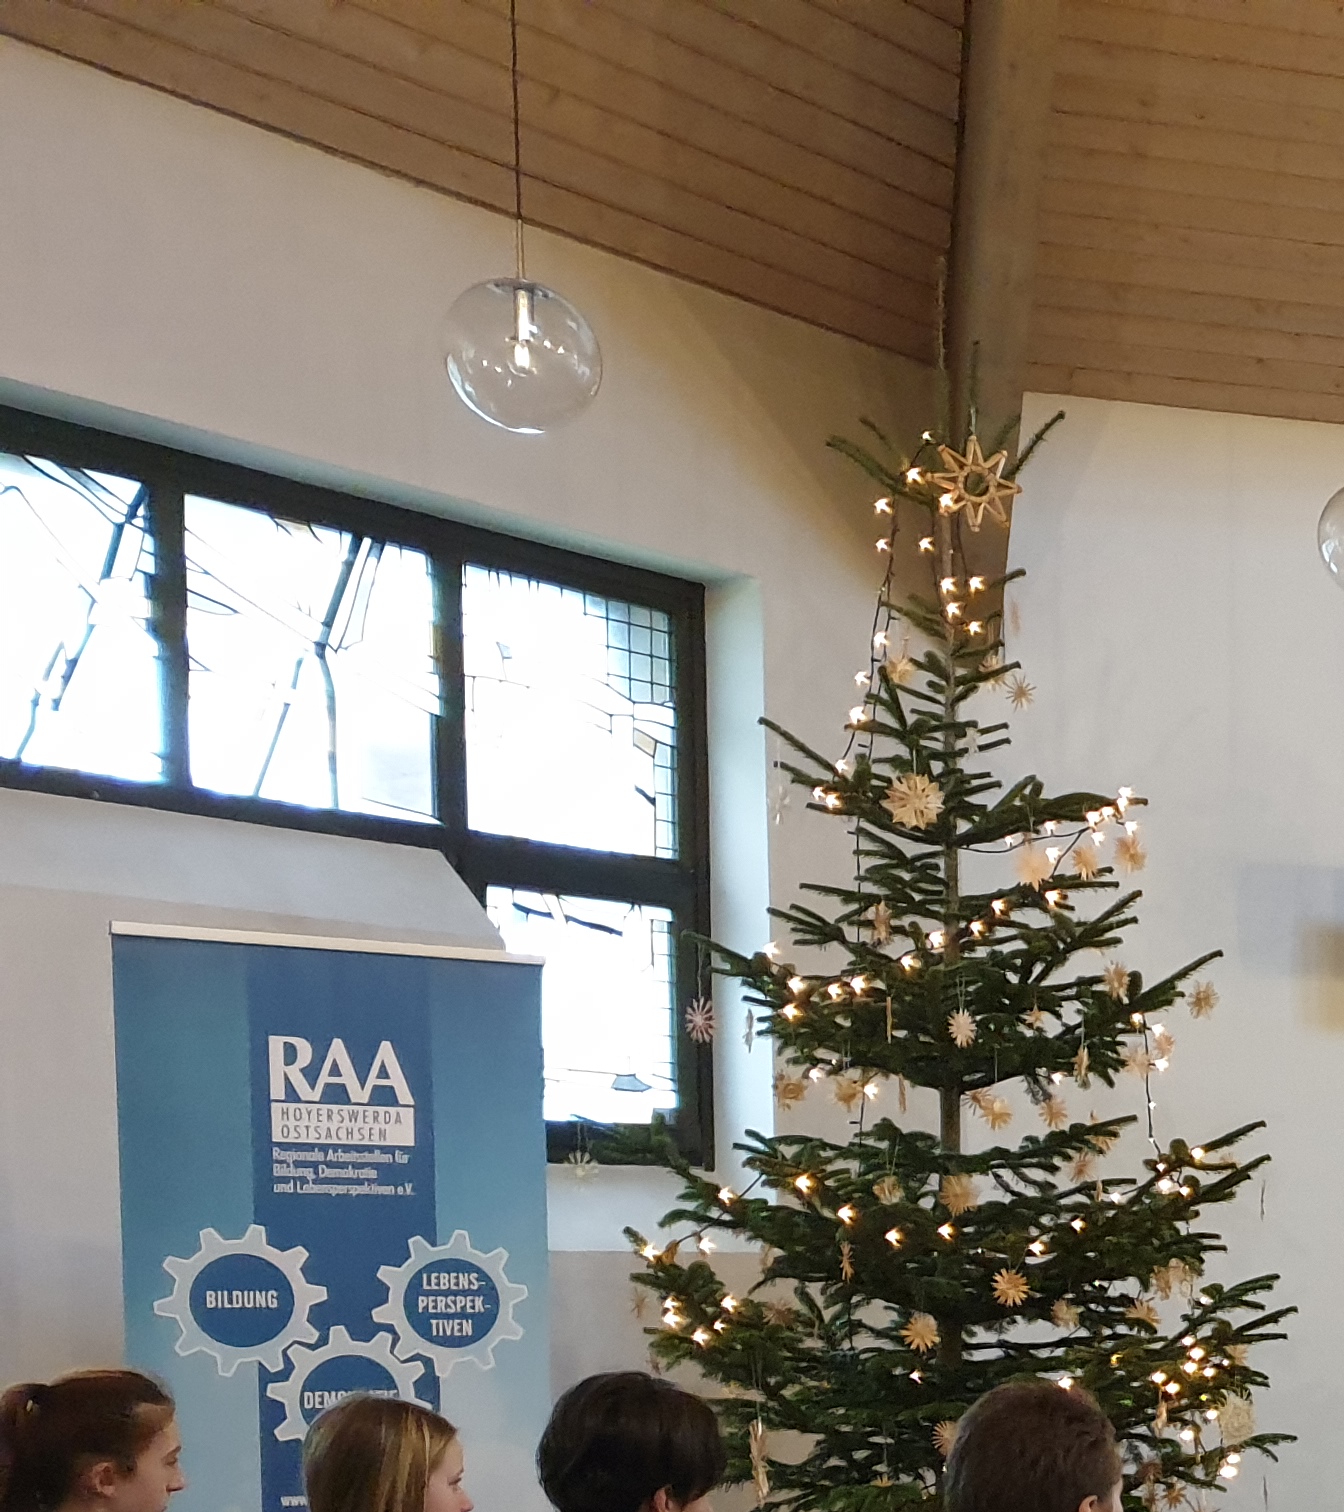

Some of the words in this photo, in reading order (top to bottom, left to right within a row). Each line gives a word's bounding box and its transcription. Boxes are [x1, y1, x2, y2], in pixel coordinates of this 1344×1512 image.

[268, 1035, 415, 1106] RAA
[280, 1107, 403, 1125] HOYERSWERDA
[281, 1124, 387, 1142] OSTSACHSEN
[272, 1147, 325, 1163] Regionale
[395, 1149, 410, 1164] für
[273, 1163, 315, 1180] Bildung,
[318, 1164, 378, 1178] Demokratie
[273, 1179, 294, 1193] und
[297, 1180, 395, 1196] Lebensperspektiven
[422, 1272, 486, 1290] LEBENS-
[206, 1290, 279, 1309] BILDUNG
[418, 1295, 491, 1314] PERSPEK-
[430, 1319, 473, 1337] TIVEN
